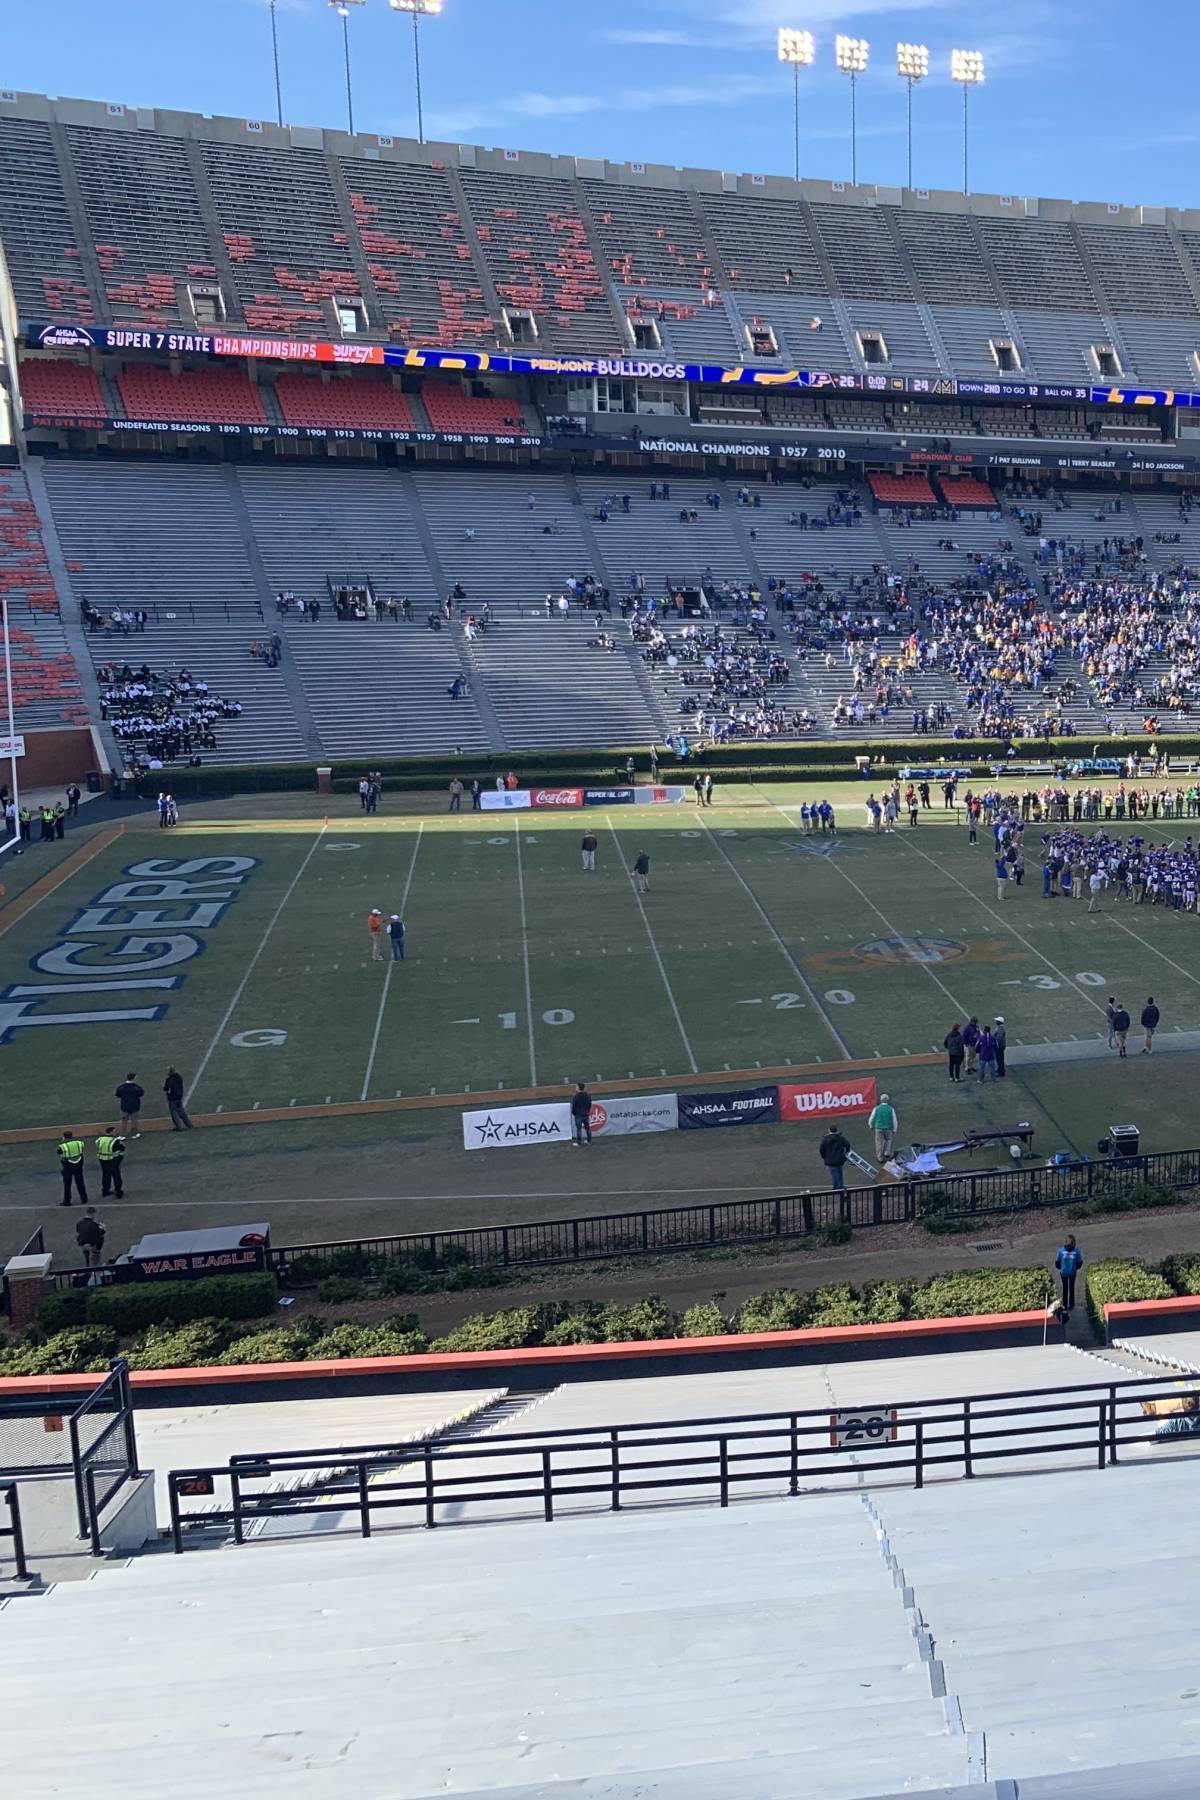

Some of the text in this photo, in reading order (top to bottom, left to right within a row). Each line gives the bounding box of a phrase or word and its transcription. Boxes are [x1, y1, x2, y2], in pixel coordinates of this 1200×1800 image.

[109, 105, 121, 113] 61
[249, 121, 260, 129] 60
[380, 136, 391, 145] 59
[754, 176, 763, 184] 56
[107, 330, 317, 358] SUPER 7 STATE CHAMPIONSHIPS
[531, 359, 686, 378] PIEDMONT BULLDOGS
[840, 376, 854, 388] 26
[868, 376, 886, 386] 0:00
[914, 380, 929, 391] 24
[960, 384, 983, 392] DOWN
[984, 384, 1000, 394] 2ND
[1029, 387, 1038, 396] 12
[1075, 389, 1086, 398] 35
[113, 421, 211, 432] UNDEFEATED SEASONS
[219, 425, 240, 433] 1893
[248, 426, 269, 434] 1897
[277, 427, 298, 436] 1900
[306, 428, 327, 437] 1904
[334, 430, 355, 438] 1913
[362, 431, 382, 439] 1914
[390, 432, 409, 440] 1932
[417, 433, 436, 441] 1957
[443, 434, 463, 442] 1958
[640, 440, 846, 459] NATIONAL CHAMPIONS 1957 2010
[911, 452, 952, 461] BROADWAY
[1011, 457, 1040, 465] SULLIVAN
[1091, 460, 1115, 468] BEASLEY
[1028, 971, 1107, 991] 30
[771, 989, 856, 1010] 20
[498, 1008, 586, 1030] 10
[229, 1028, 288, 1048] G
[692, 1096, 774, 1115] AHSAA FOOTBALL
[794, 1090, 865, 1113] Wilson
[504, 1120, 560, 1139] AHSAA
[140, 1251, 256, 1274] WAR EAGLE
[184, 1481, 208, 1493] 26
